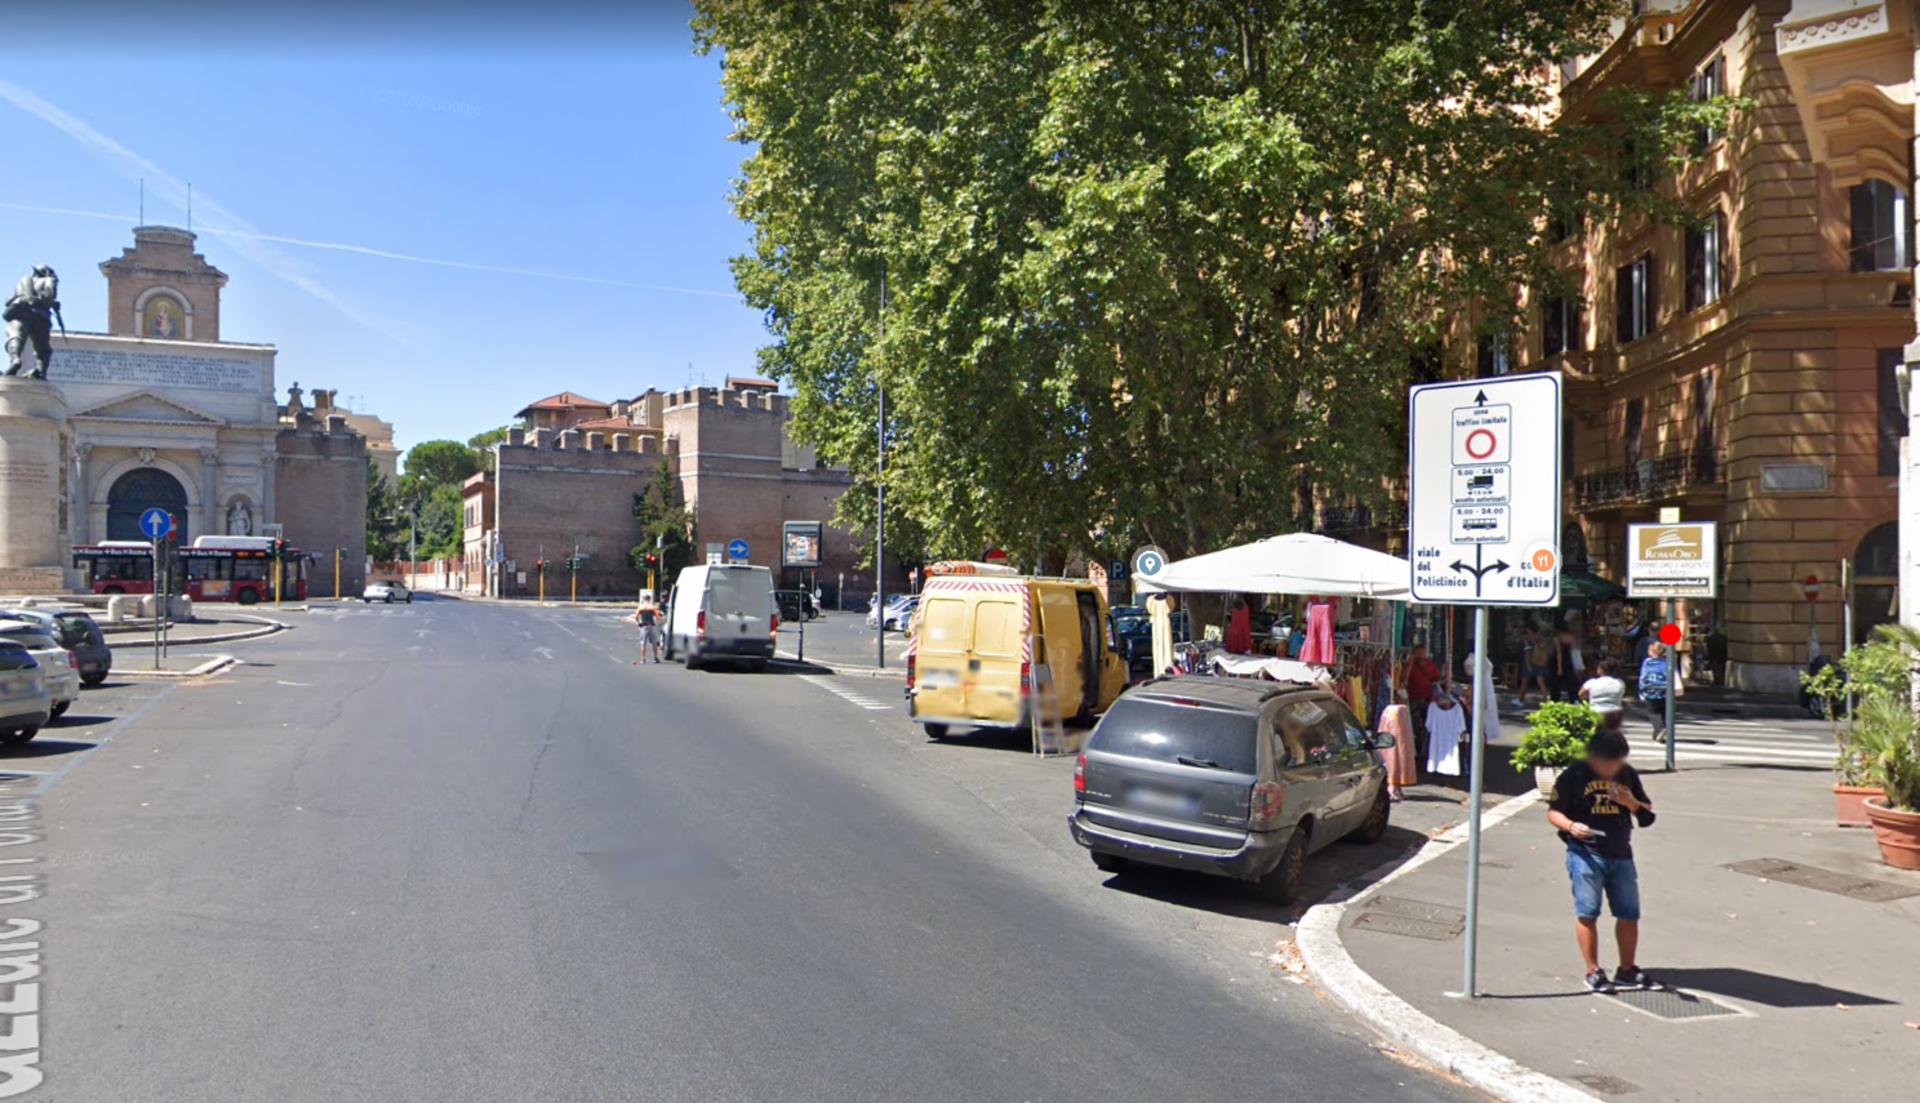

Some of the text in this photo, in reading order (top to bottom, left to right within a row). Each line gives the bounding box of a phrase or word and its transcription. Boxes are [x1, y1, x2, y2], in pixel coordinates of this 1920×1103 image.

[1417, 547, 1440, 557] viale
[1417, 561, 1431, 571] del
[1417, 576, 1468, 587] Policlinico
[1507, 576, 1549, 588] d'Italia
